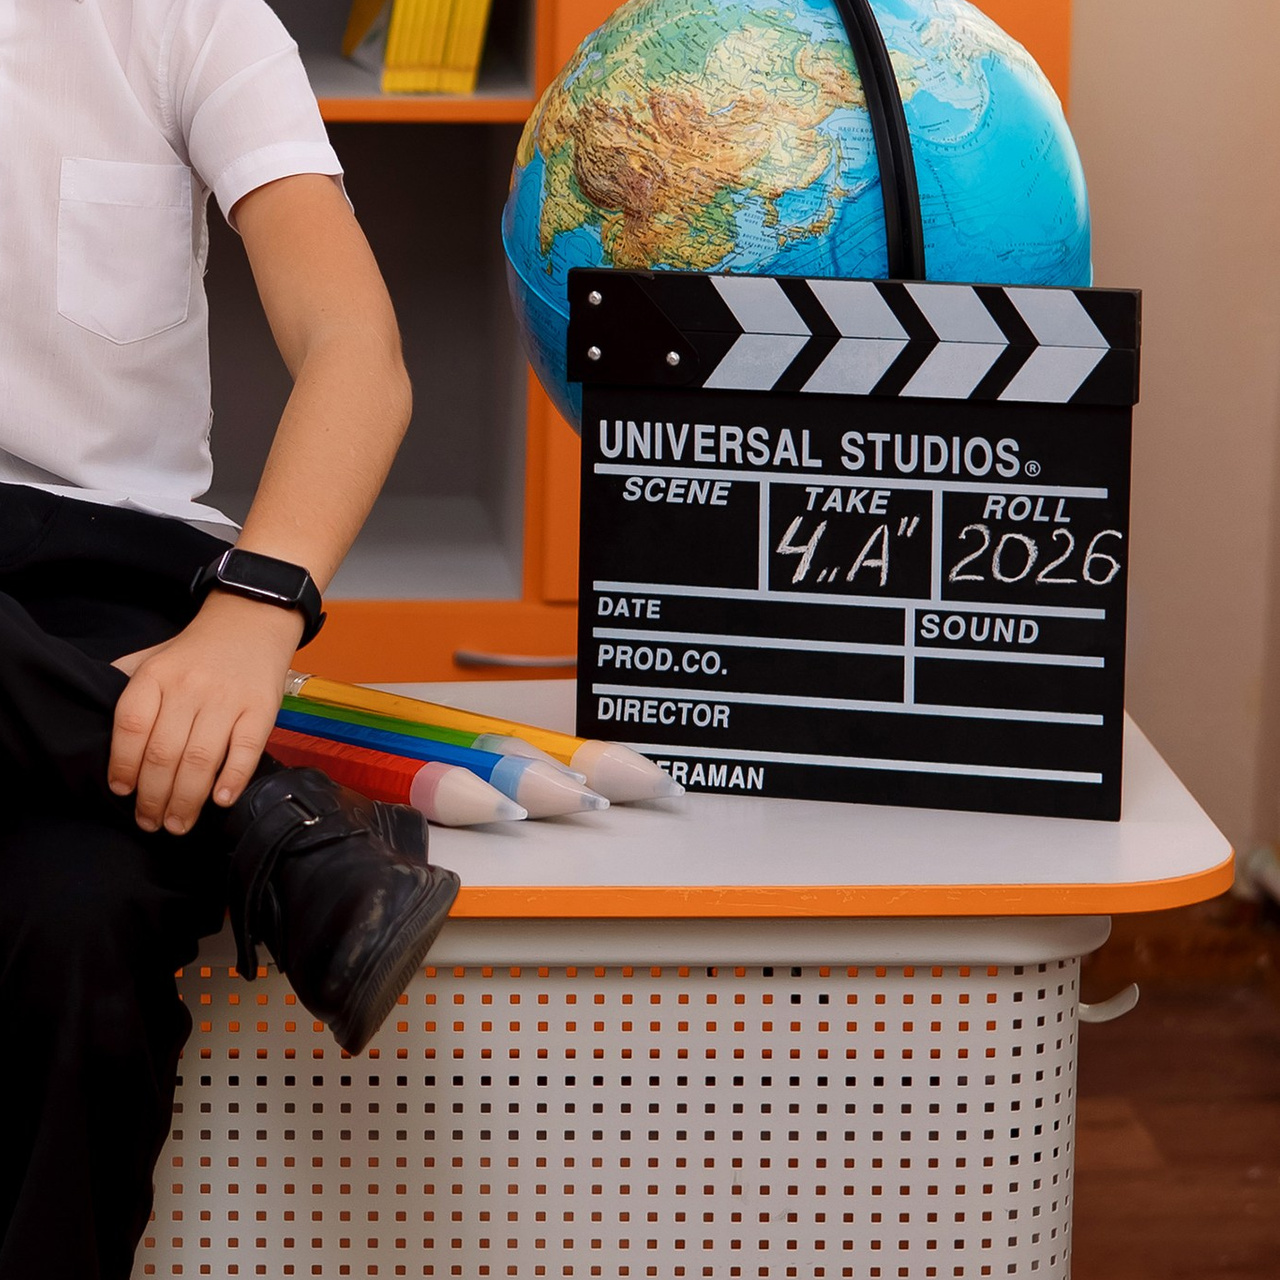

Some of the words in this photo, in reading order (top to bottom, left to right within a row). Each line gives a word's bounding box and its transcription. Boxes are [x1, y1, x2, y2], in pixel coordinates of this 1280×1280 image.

[599, 419, 822, 467] UNIVERSAL
[623, 477, 732, 506] SCENE
[805, 487, 891, 515] TAKE
[983, 495, 1071, 523] ROLL
[949, 524, 1123, 586] 2026
[597, 597, 661, 620] DATE
[921, 614, 1039, 643] SOUND
[597, 645, 728, 675] PROD.CO.
[598, 697, 730, 728] DIRECTOR
